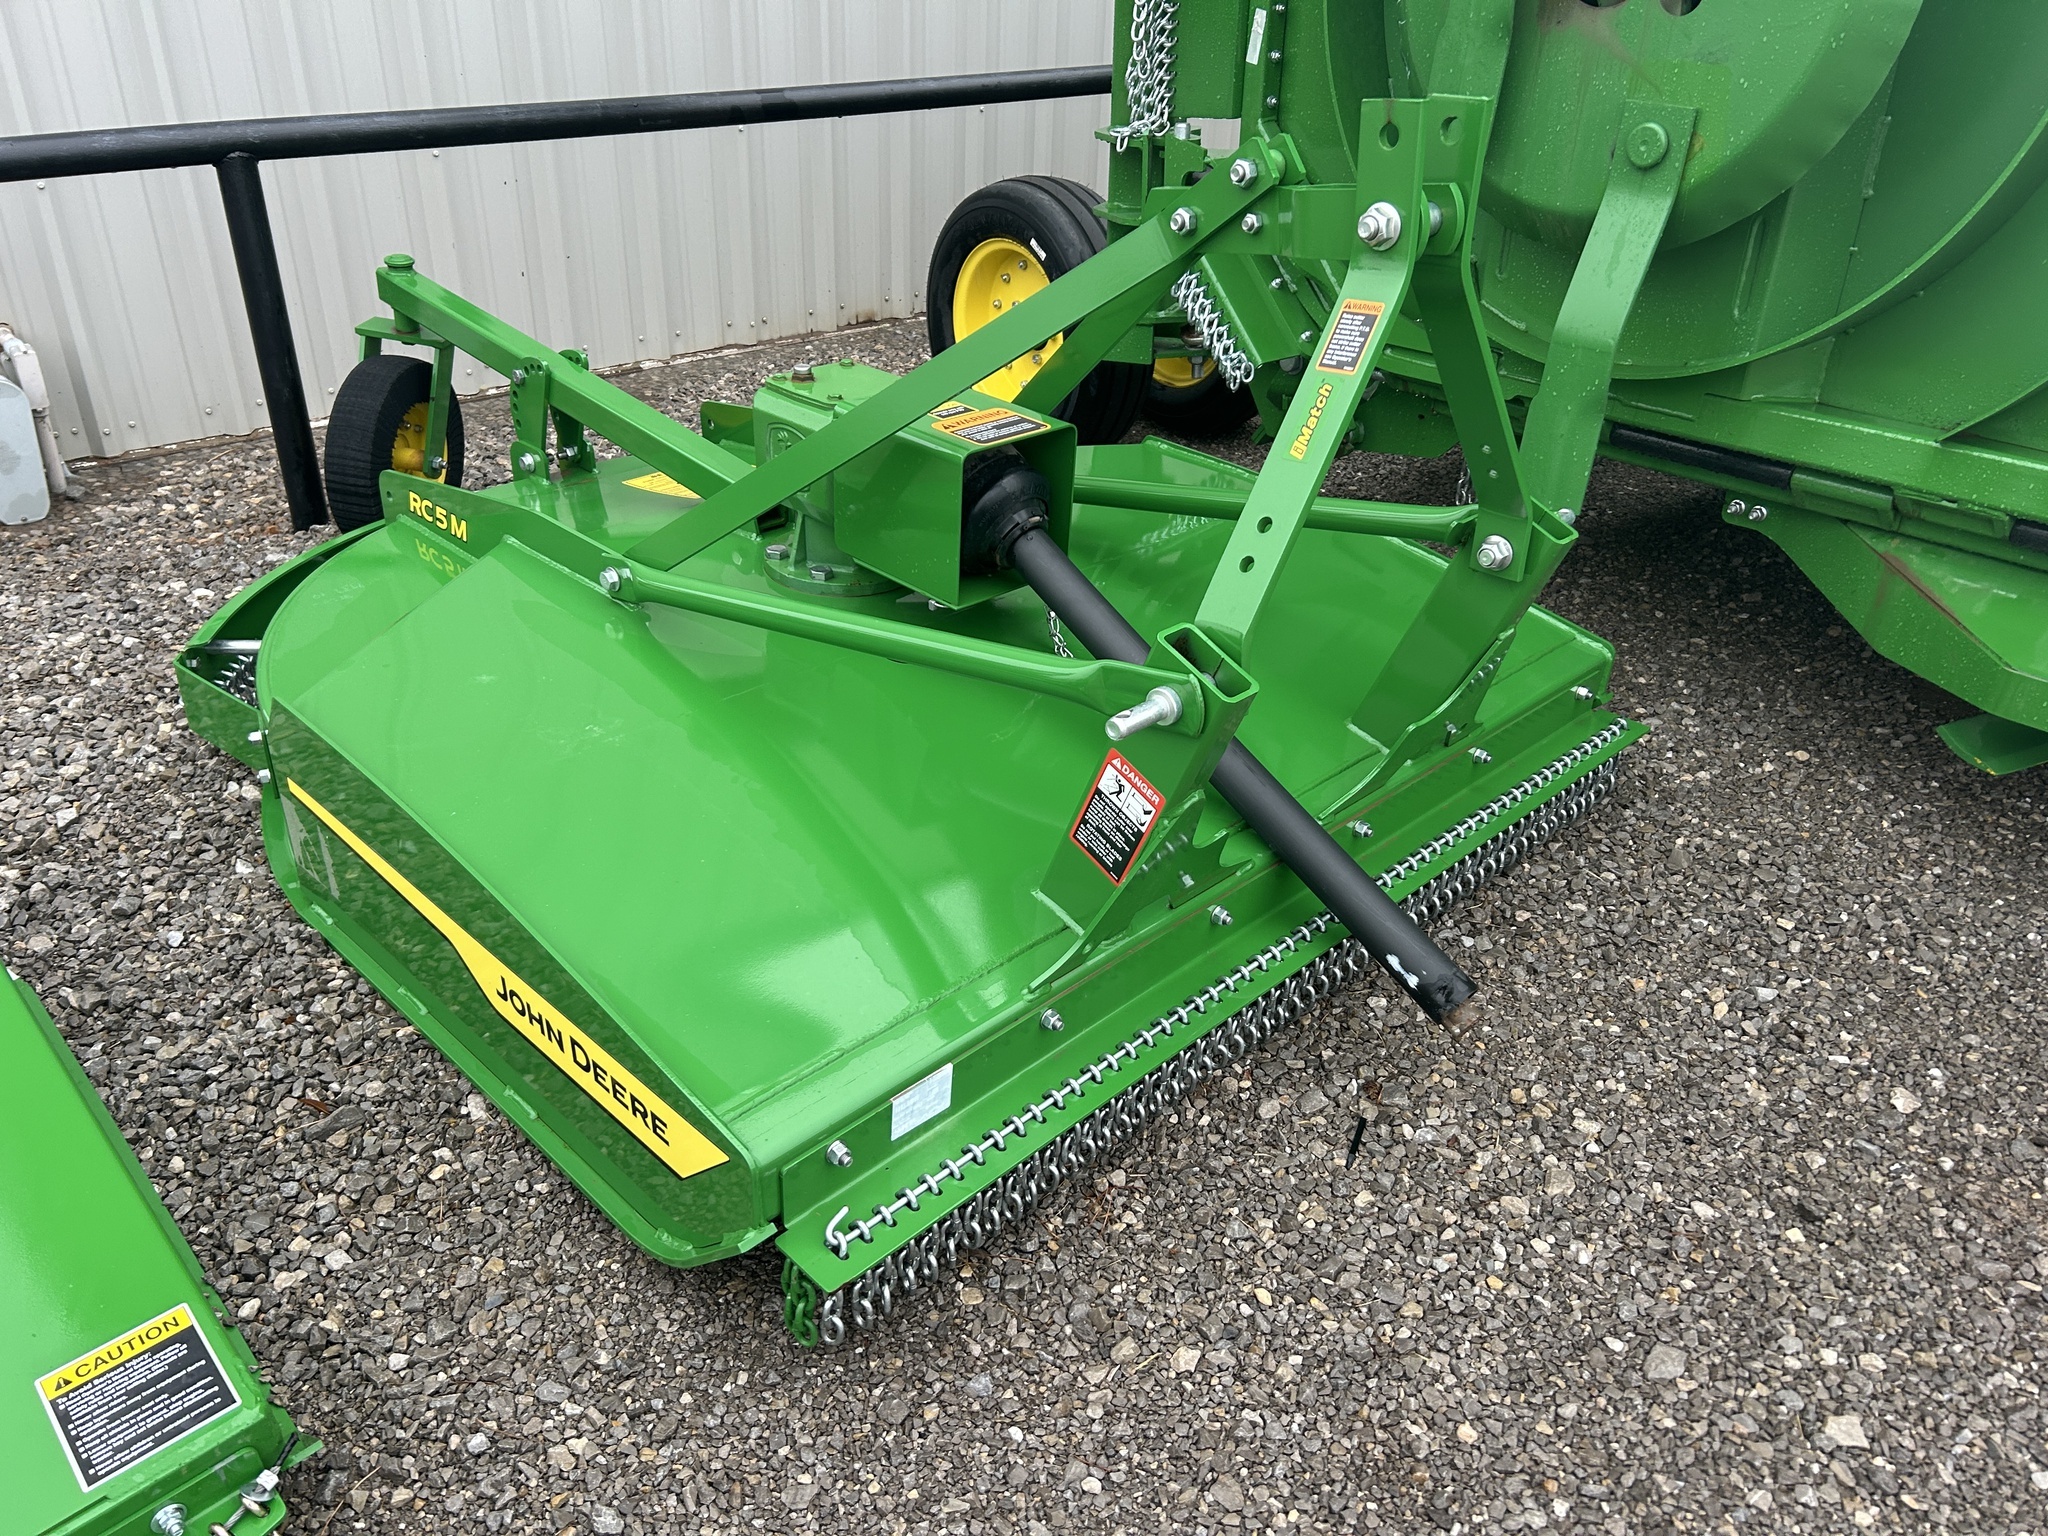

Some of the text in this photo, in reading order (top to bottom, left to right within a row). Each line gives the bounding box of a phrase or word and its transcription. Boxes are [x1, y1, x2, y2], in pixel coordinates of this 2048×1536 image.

[1352, 303, 1382, 313] WARNING
[955, 410, 1008, 426] WARNING
[1121, 764, 1160, 805] DANGER
[496, 975, 670, 1147] JOHN DEERE
[75, 1316, 180, 1378] CAUTION
[67, 1382, 92, 1399] Avoid
